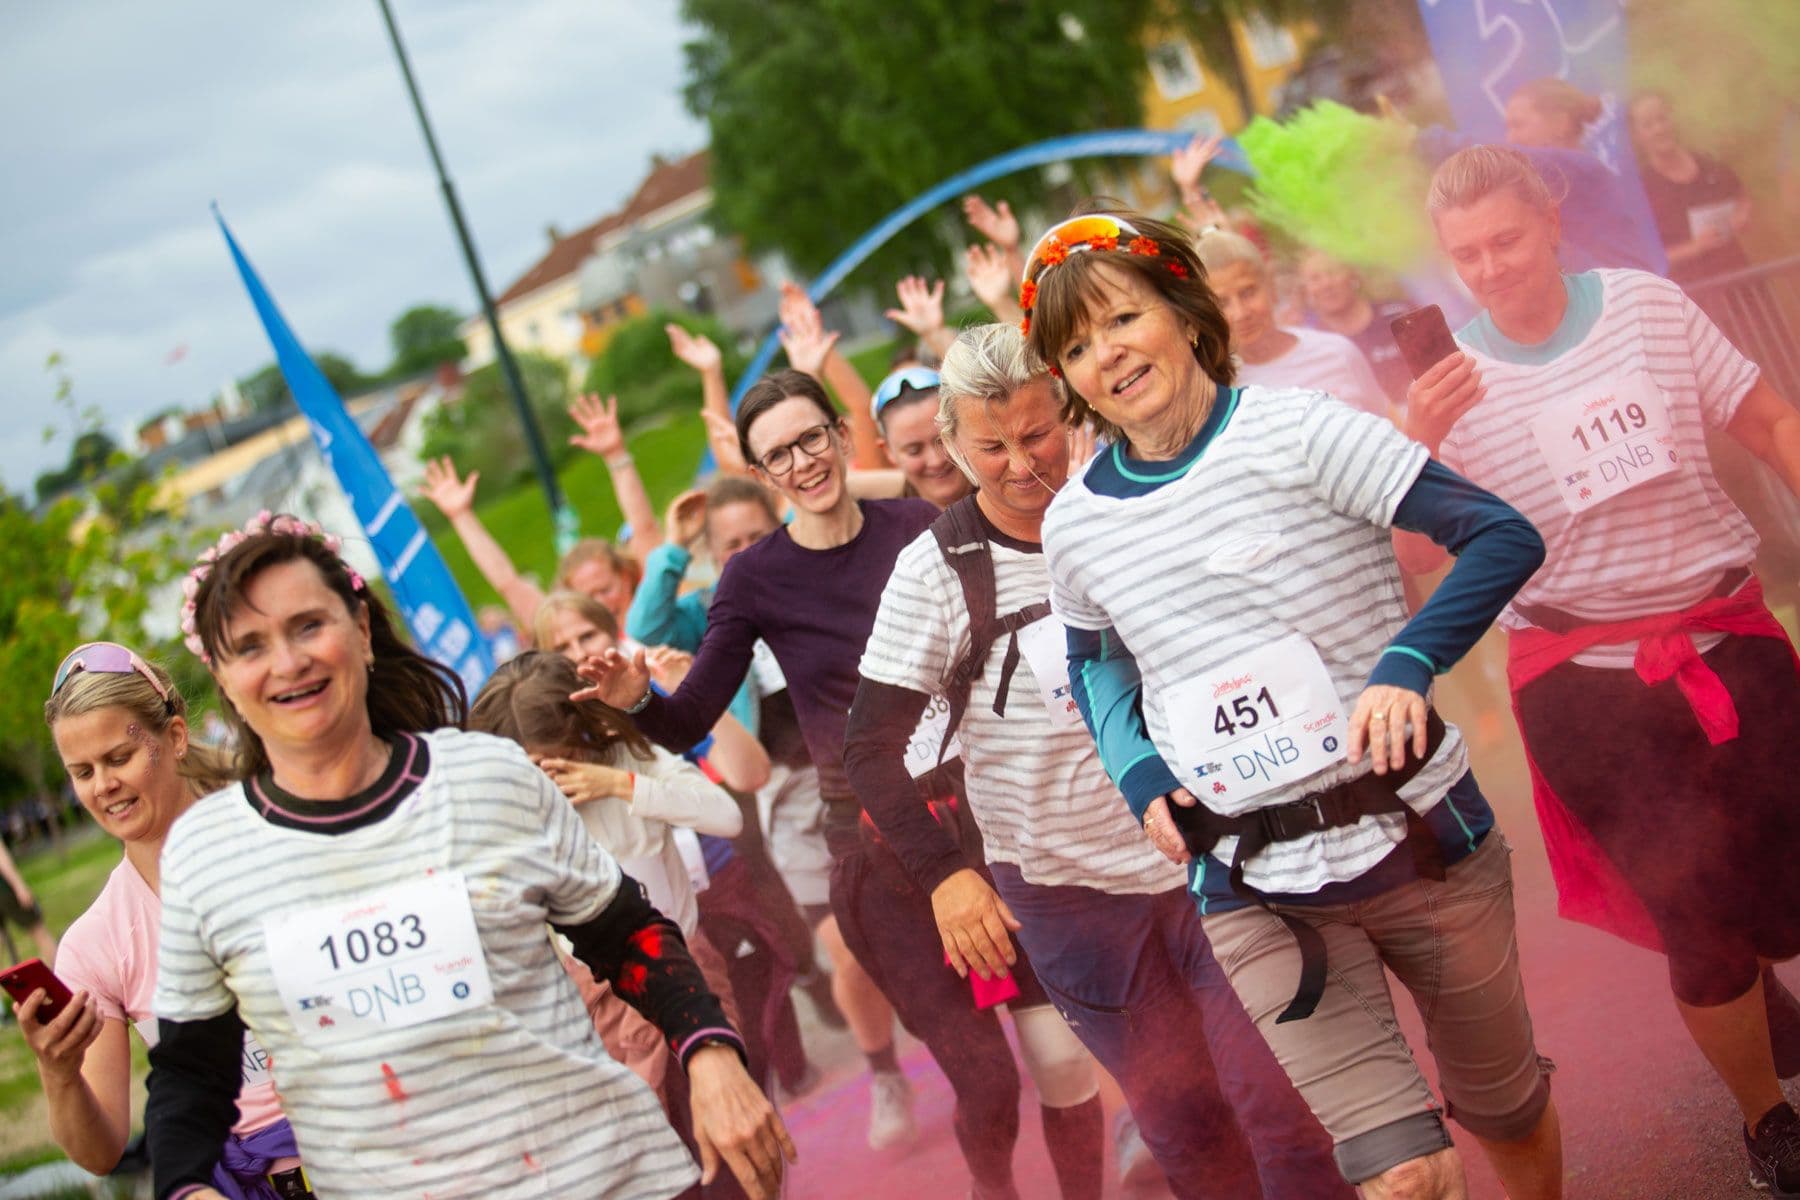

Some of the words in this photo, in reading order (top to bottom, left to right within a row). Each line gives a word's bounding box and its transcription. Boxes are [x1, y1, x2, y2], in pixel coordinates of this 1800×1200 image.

[1572, 403, 1646, 451] 1119
[1598, 443, 1654, 483] DNB
[1214, 686, 1279, 736] 451
[1232, 734, 1300, 782] DNB
[319, 914, 427, 970] 1083
[347, 967, 427, 1023] DNB
